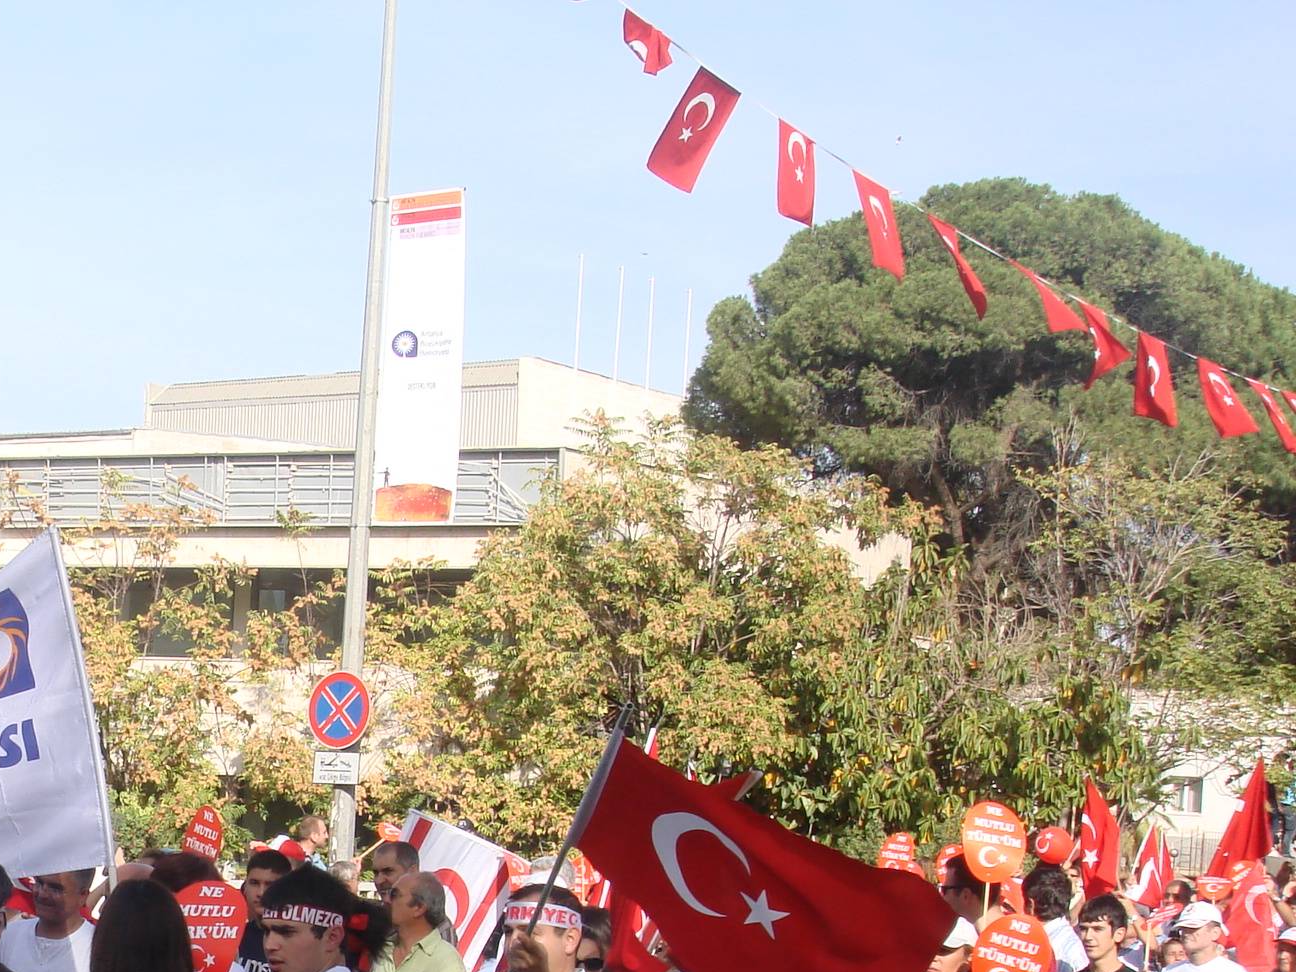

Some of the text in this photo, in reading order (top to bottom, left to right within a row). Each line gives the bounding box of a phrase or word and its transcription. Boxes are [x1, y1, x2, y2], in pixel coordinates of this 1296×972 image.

[985, 806, 1003, 816] NE
[974, 817, 1014, 832] MUTLU
[199, 886, 225, 898] NE
[179, 904, 236, 918] MUTLU
[187, 922, 239, 939] RK'ÜM
[1010, 919, 1031, 934] NE
[990, 932, 1040, 955] MUTLU
